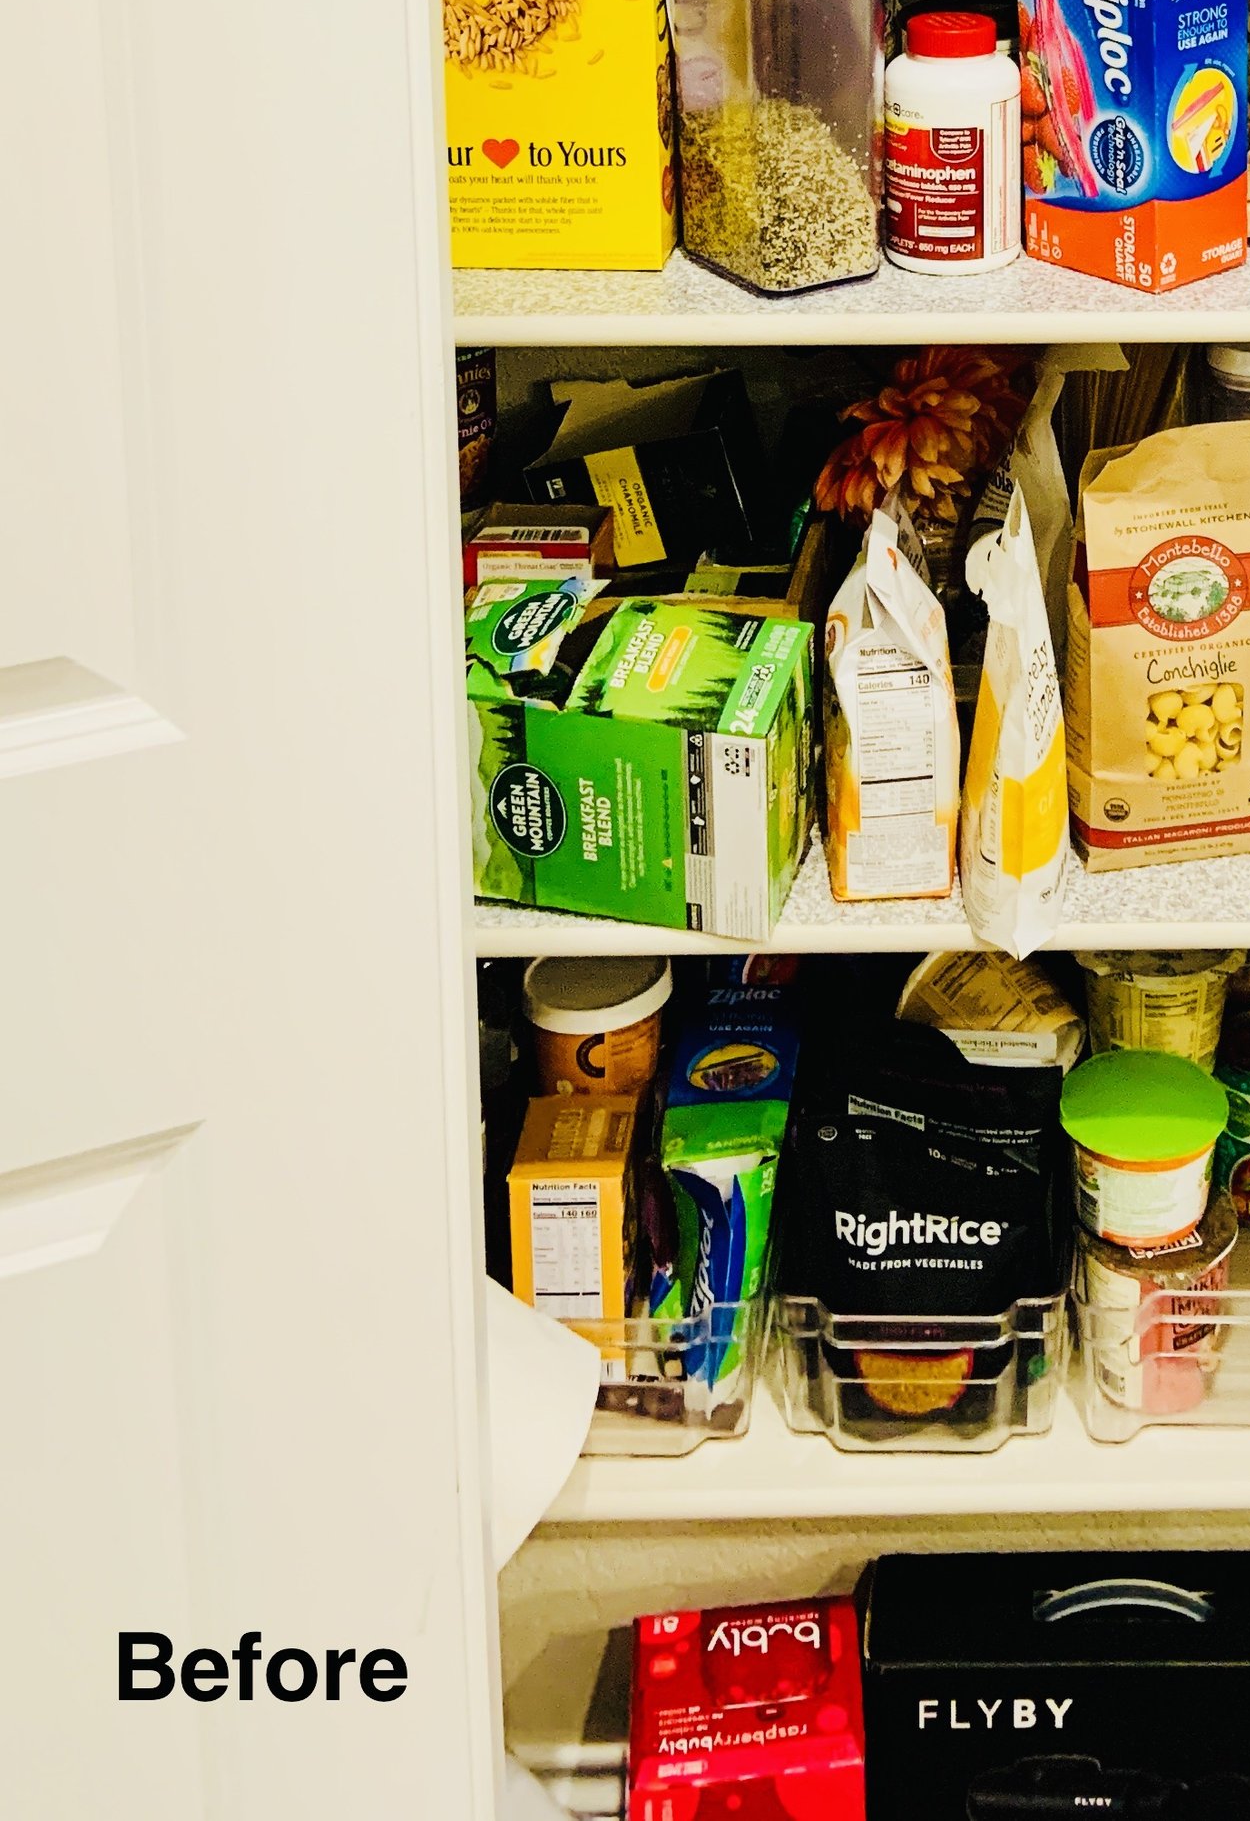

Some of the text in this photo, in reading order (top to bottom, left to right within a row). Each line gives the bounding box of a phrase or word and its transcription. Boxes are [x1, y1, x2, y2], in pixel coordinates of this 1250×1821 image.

[1177, 3, 1228, 29] STRONG
[1177, 18, 1228, 41] ENOUGH TO
[1177, 29, 1229, 52] USE AGAIN
[448, 141, 628, 168] ur to Yours
[1113, 116, 1129, 196] Grip Seal
[448, 175, 468, 184] oats
[469, 177, 489, 185] your
[491, 175, 514, 184] heart
[516, 175, 534, 184] will
[536, 175, 564, 184] thank
[566, 177, 582, 185] you
[949, 242, 975, 253] EACH
[1114, 238, 1126, 281] QUART
[1122, 215, 1152, 288] STORAGE 50
[1200, 236, 1243, 263] STORAGE
[618, 477, 644, 537] CHAMOMILE
[631, 482, 655, 528] ORGANIC
[1179, 502, 1230, 515] FROM ITALY
[1125, 519, 1196, 535] STONEWALL
[1140, 538, 1232, 577] Montebello
[507, 601, 541, 642] GREEN
[517, 592, 565, 649] MOUNTAIN
[1136, 607, 1210, 640] Established
[1214, 594, 1244, 627] 1388
[609, 618, 658, 690] BREAKFAST
[633, 632, 667, 675] BLEND
[859, 646, 898, 657] Nutrition
[1133, 644, 1196, 661] CERTIFIED
[858, 673, 931, 691] Calories 140
[1146, 651, 1238, 685] Conchiglie
[728, 706, 759, 736] 24
[510, 783, 528, 838] GREEN
[525, 771, 545, 852] MOUNTAIN
[578, 777, 599, 862] BREAKFAST
[595, 796, 614, 847] BLEND
[1122, 832, 1161, 845] ITALIAN
[1163, 826, 1213, 839] MACARONI
[707, 987, 782, 1007] Ziploc
[894, 1109, 924, 1126] Facts
[532, 1183, 598, 1191] Nutrition Facts
[561, 1209, 598, 1219] 140 160
[834, 1209, 1003, 1257] RightRice
[848, 1257, 985, 1271] MADE FROM VEGETABLES
[707, 1621, 821, 1657] bubly
[918, 1697, 1074, 1730] FLYBY
[1073, 1796, 1113, 1807] FLYBY
